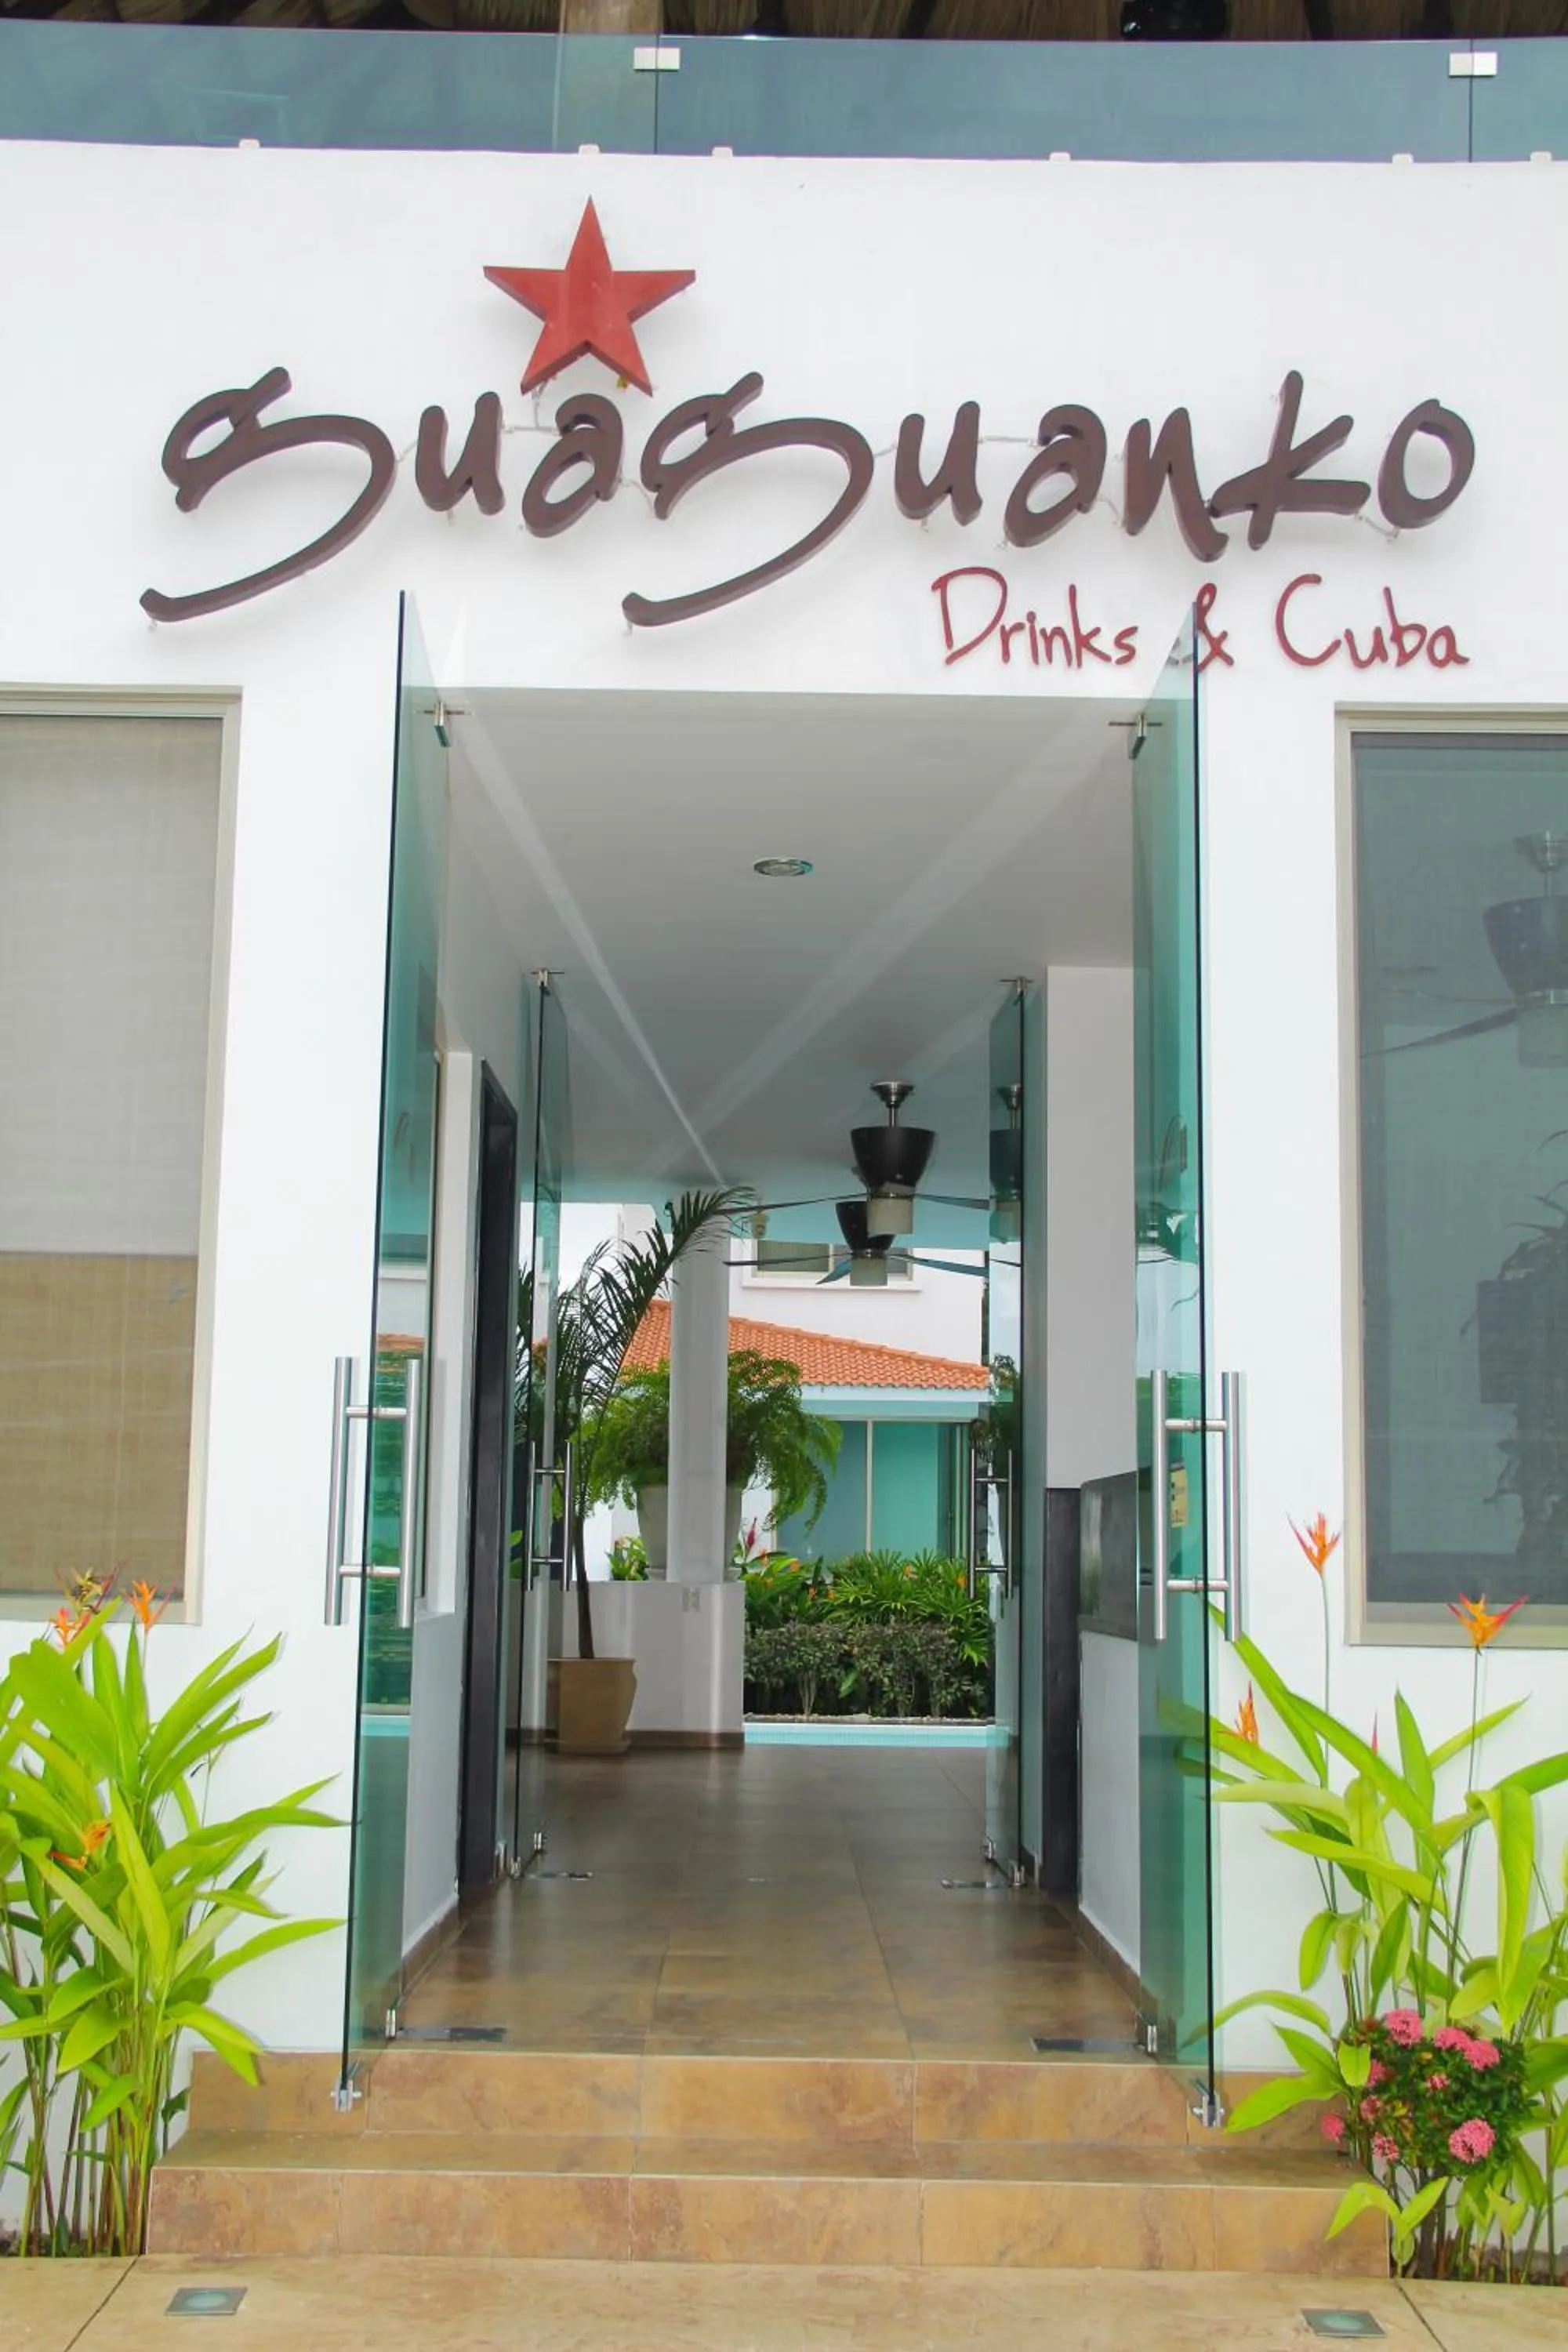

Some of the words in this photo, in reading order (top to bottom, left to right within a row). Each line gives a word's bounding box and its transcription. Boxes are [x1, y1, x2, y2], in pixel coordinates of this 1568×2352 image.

[931, 566, 1139, 670] Drinks
[1179, 583, 1234, 672] &
[1275, 573, 1470, 669] Cuba
